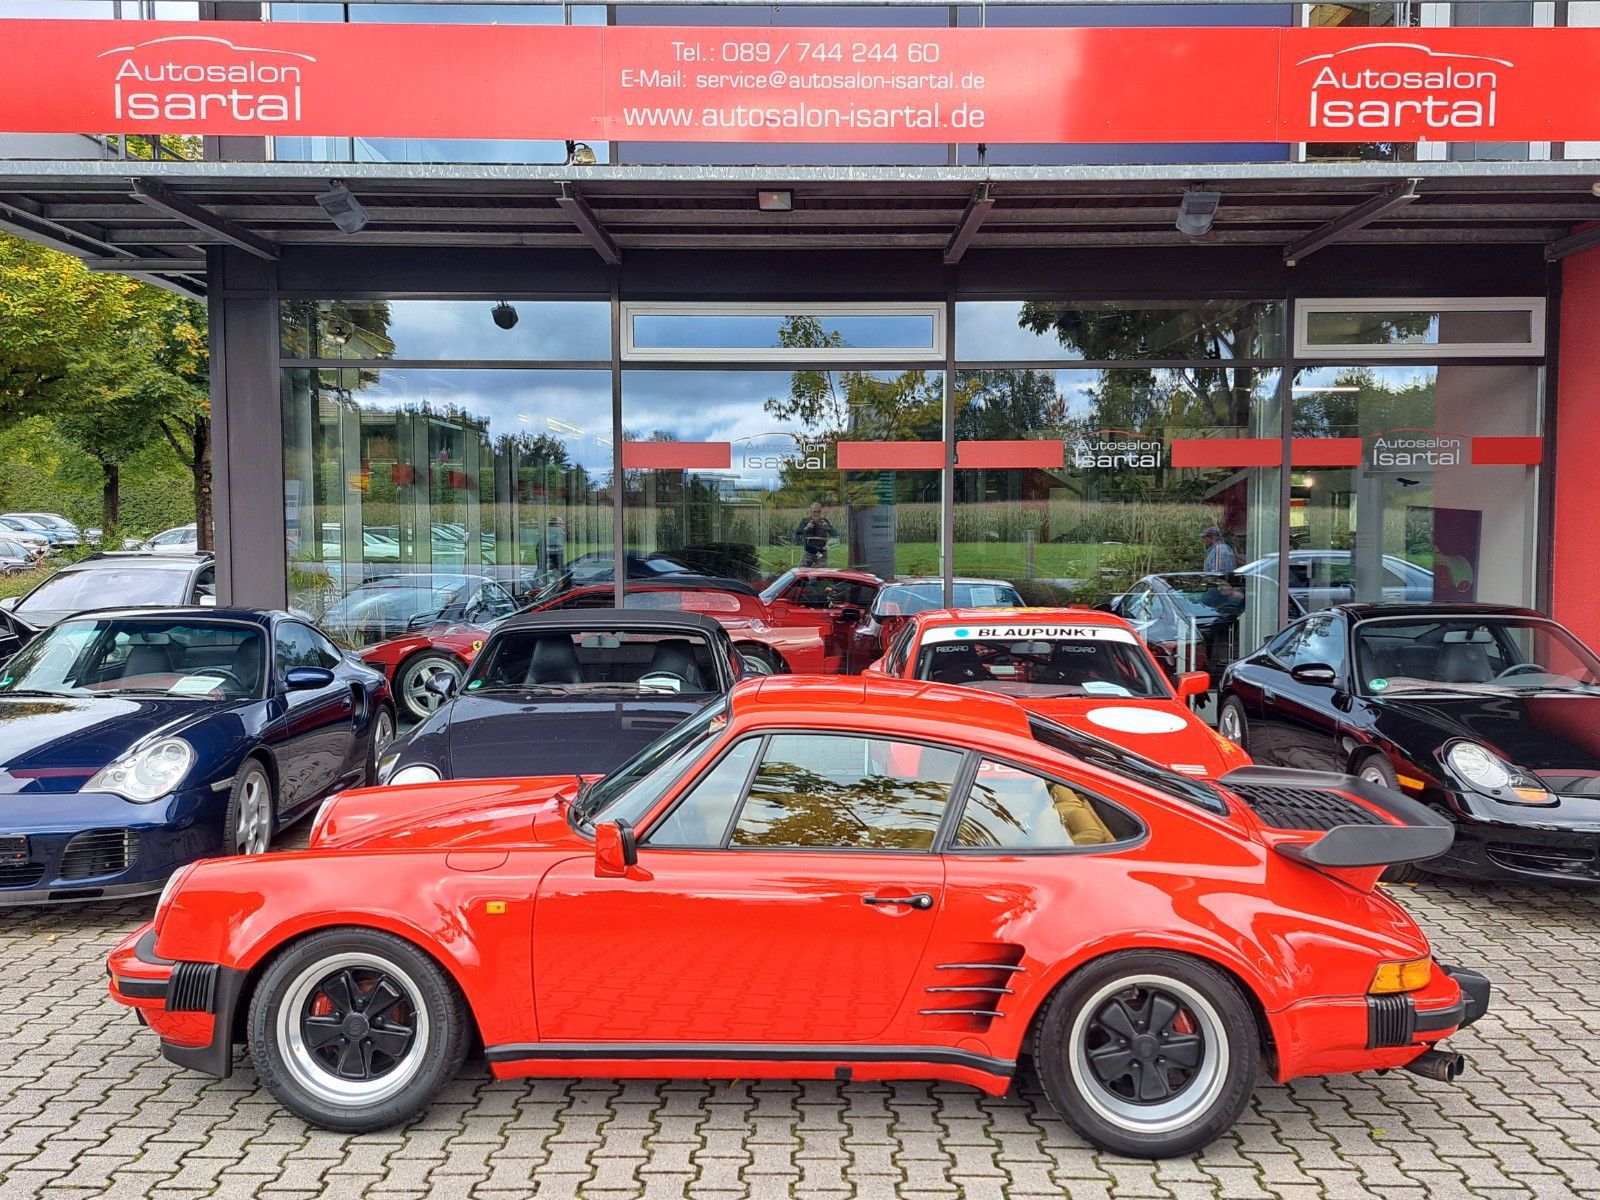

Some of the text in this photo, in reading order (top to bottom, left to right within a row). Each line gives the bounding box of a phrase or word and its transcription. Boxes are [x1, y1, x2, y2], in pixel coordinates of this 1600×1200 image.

[671, 41, 715, 63] Tel.:
[722, 42, 771, 64] 089
[796, 42, 843, 64] 744
[852, 42, 899, 64] 244
[907, 42, 940, 64] 60
[115, 59, 301, 83] Autosalon
[621, 69, 985, 89] E-Mail: service@autosalon-isartal.de
[1311, 66, 1497, 89] Autosalon
[114, 83, 301, 121] Isartal
[1309, 90, 1497, 128] Isartal
[623, 102, 985, 128] www.autosalon-isartal.de
[1076, 440, 1161, 451] Autosalon
[1374, 437, 1460, 449] Autosalon
[743, 454, 827, 469] Isartal
[1075, 450, 1161, 468] Isartal
[1373, 449, 1460, 466] Isartal
[977, 628, 1101, 639] BLAUPUNKT
[935, 645, 970, 654] RECARO
[1061, 645, 1097, 655] RECARO
